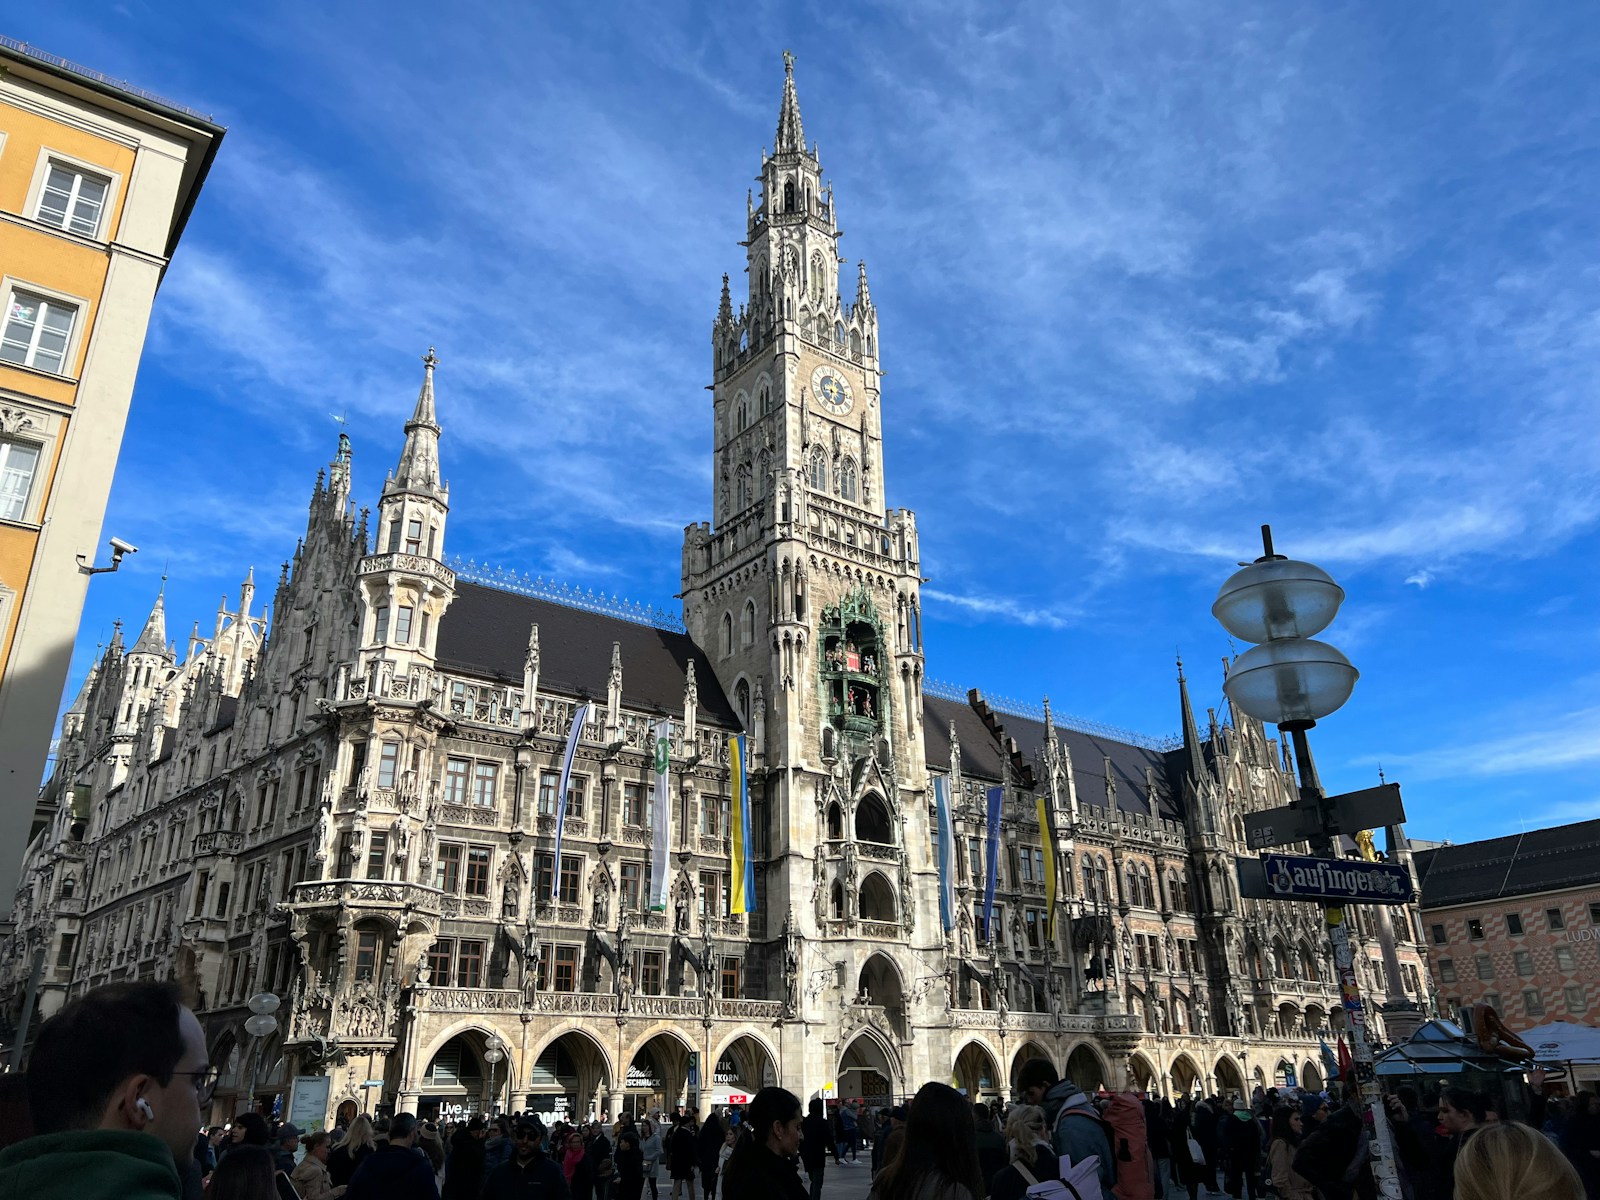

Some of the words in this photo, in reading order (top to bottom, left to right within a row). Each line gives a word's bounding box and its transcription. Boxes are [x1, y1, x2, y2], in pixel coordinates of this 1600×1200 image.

[1274, 859, 1405, 896] Kaufingertr.
[689, 1053, 696, 1067] S
[1285, 1064, 1293, 1075] S
[689, 1070, 696, 1083] U
[1286, 1075, 1295, 1086] U
[439, 1101, 463, 1115] Live
